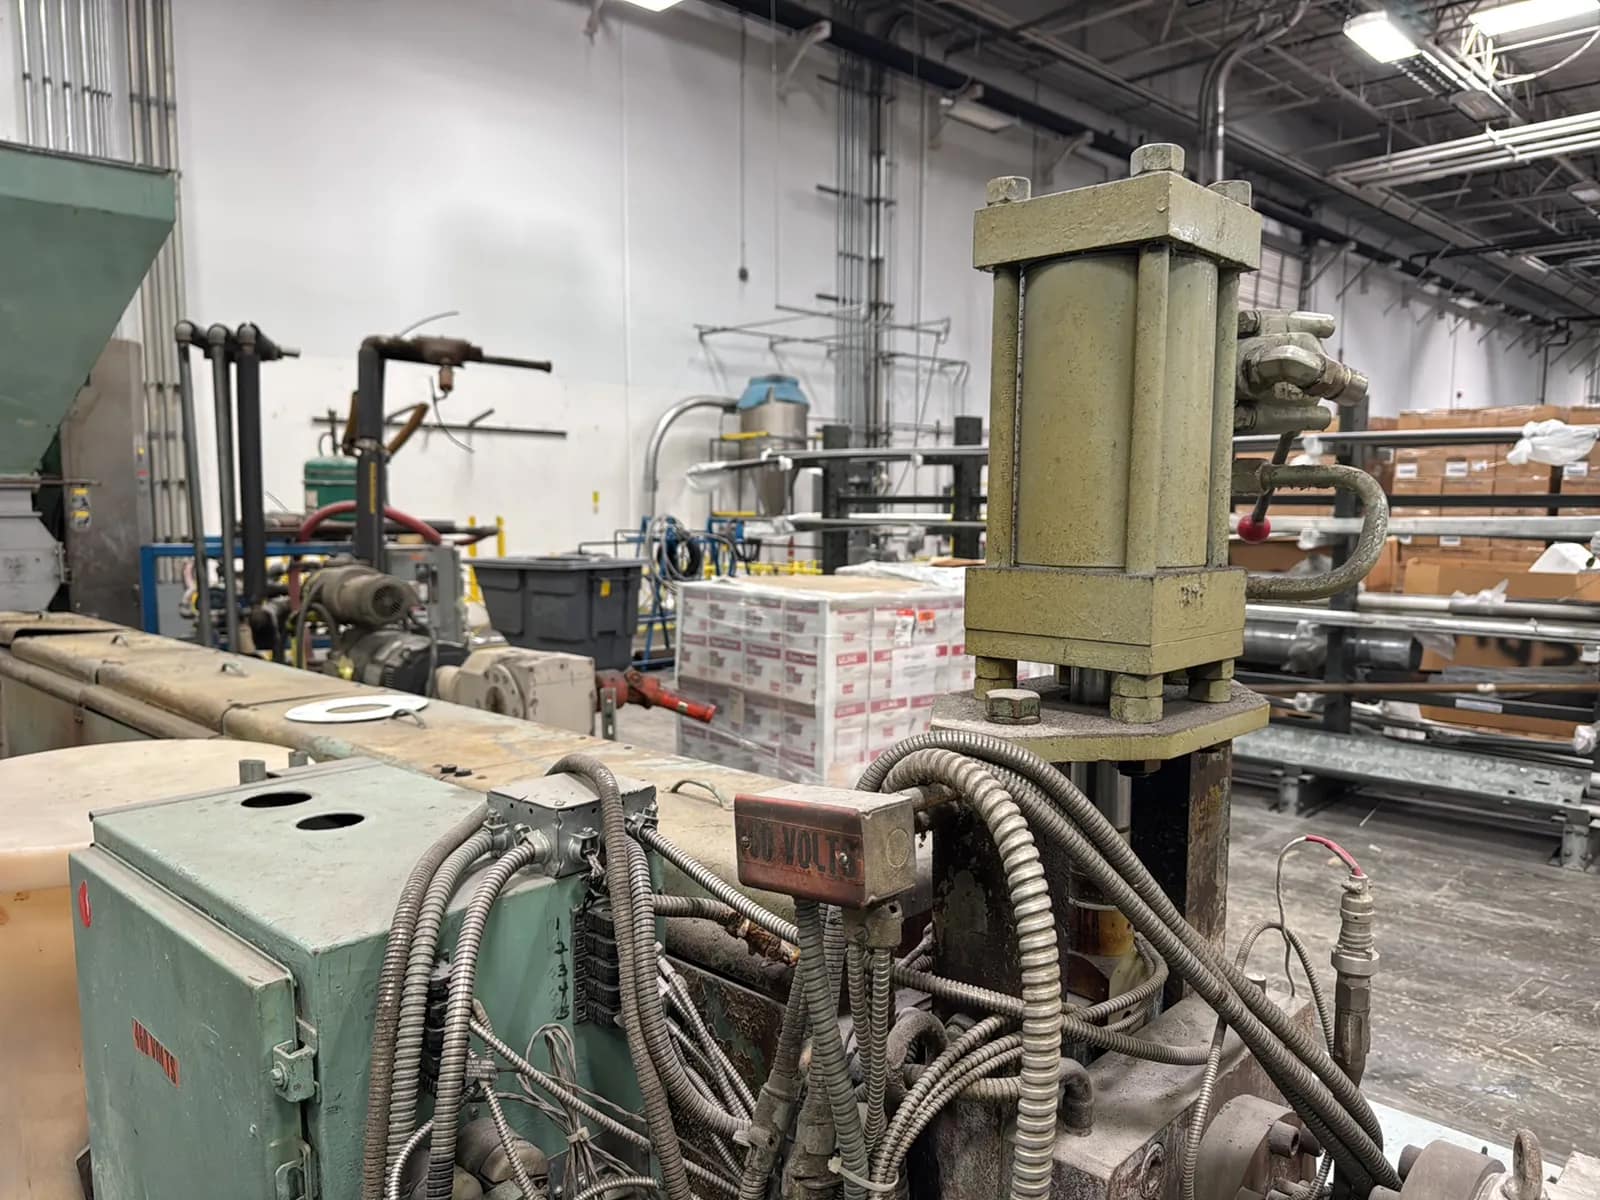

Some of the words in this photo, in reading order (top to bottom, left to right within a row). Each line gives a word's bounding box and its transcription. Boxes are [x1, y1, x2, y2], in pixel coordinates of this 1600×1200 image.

[781, 825, 858, 878] VOLTS
[554, 941, 569, 955] 2
[558, 963, 569, 978] 3
[558, 981, 569, 1000] 4
[556, 1003, 570, 1020] 5
